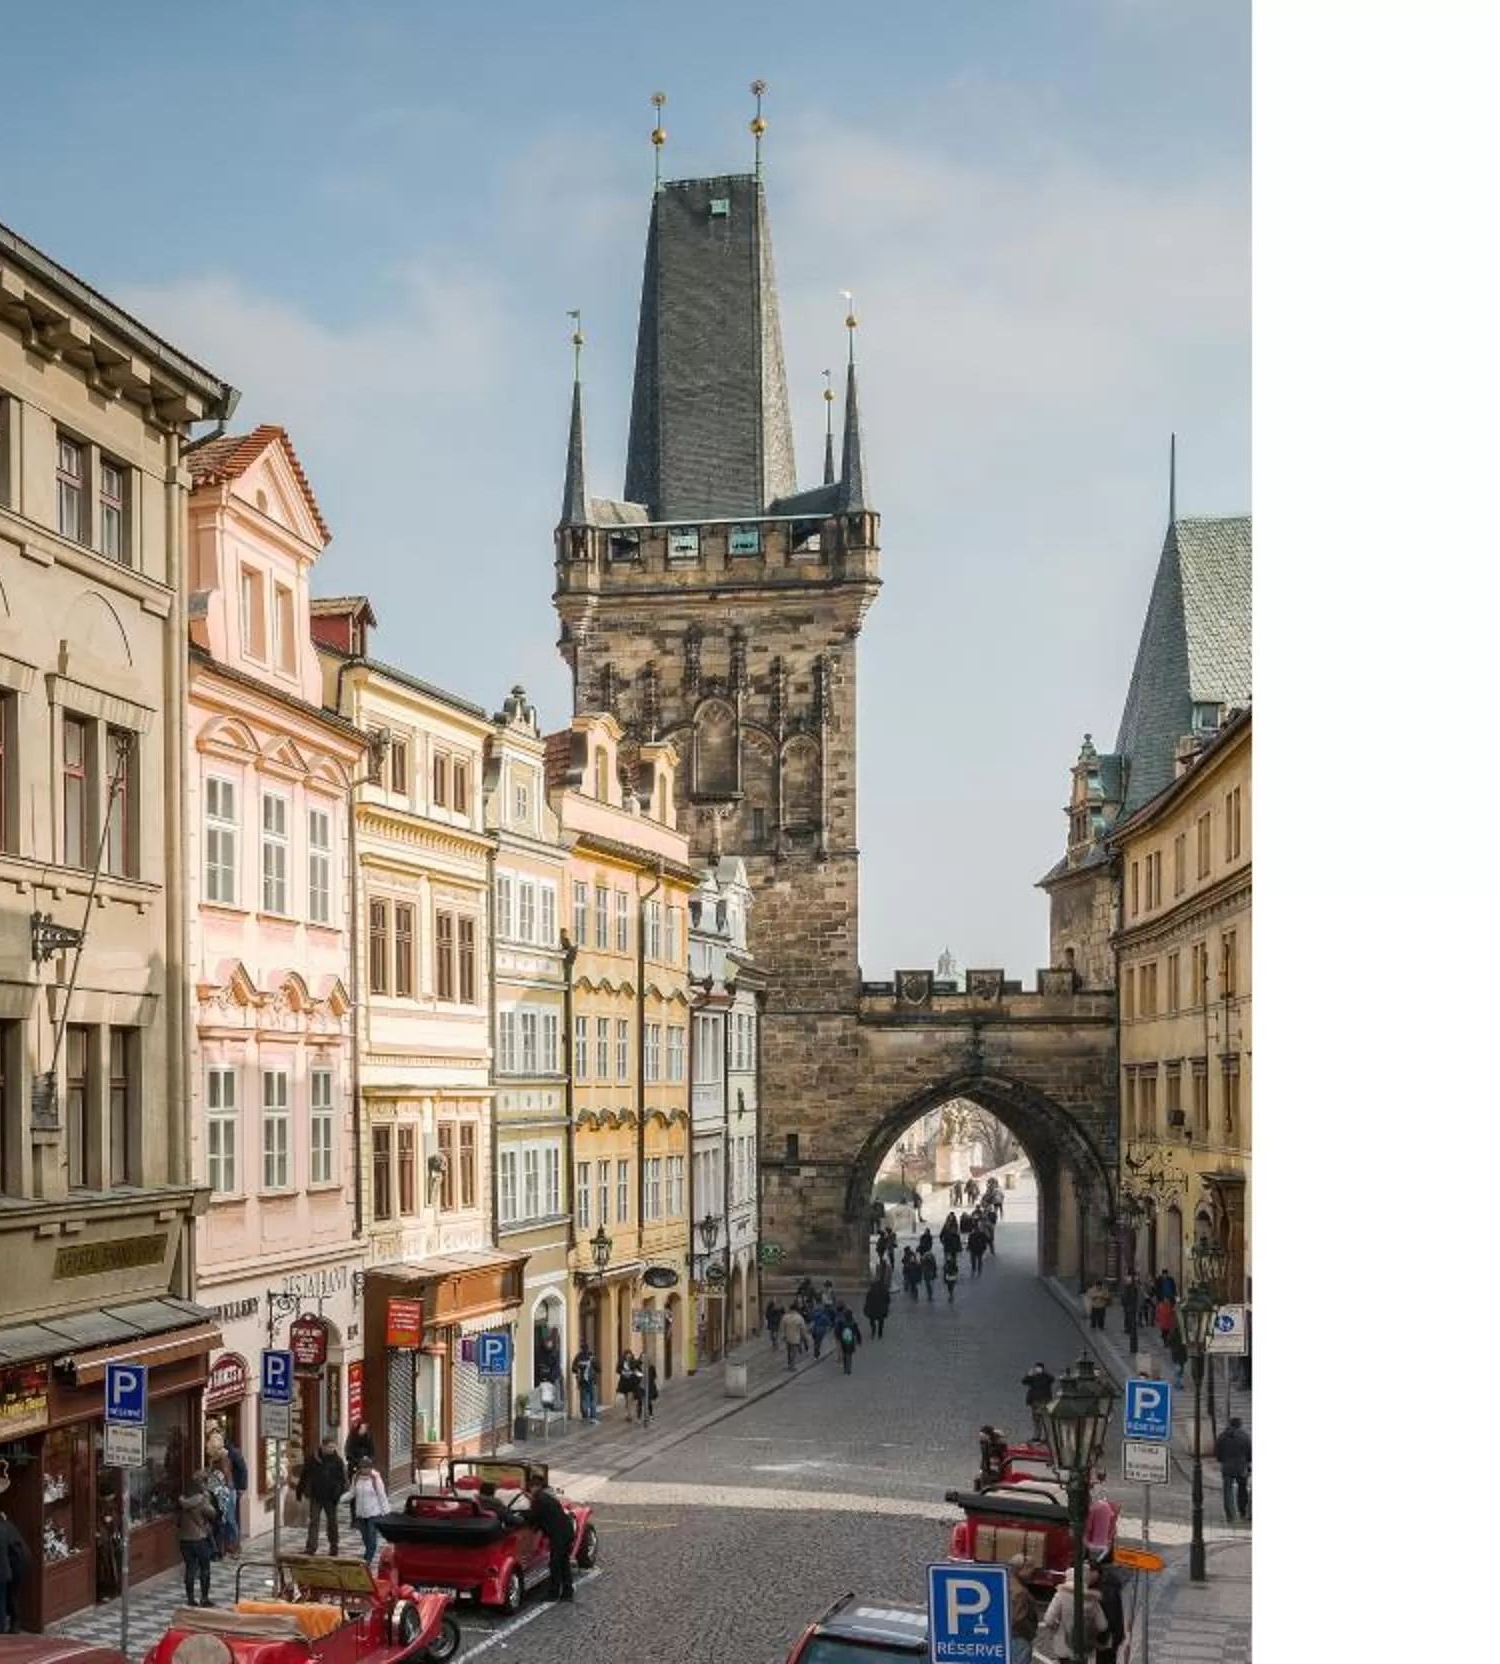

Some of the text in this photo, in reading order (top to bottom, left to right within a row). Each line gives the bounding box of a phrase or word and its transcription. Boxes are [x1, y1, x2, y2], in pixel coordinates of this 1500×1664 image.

[485, 1339, 503, 1366] P
[267, 1355, 285, 1386] P
[113, 1370, 137, 1405] P
[1133, 1387, 1161, 1418] P
[946, 1579, 991, 1635] P
